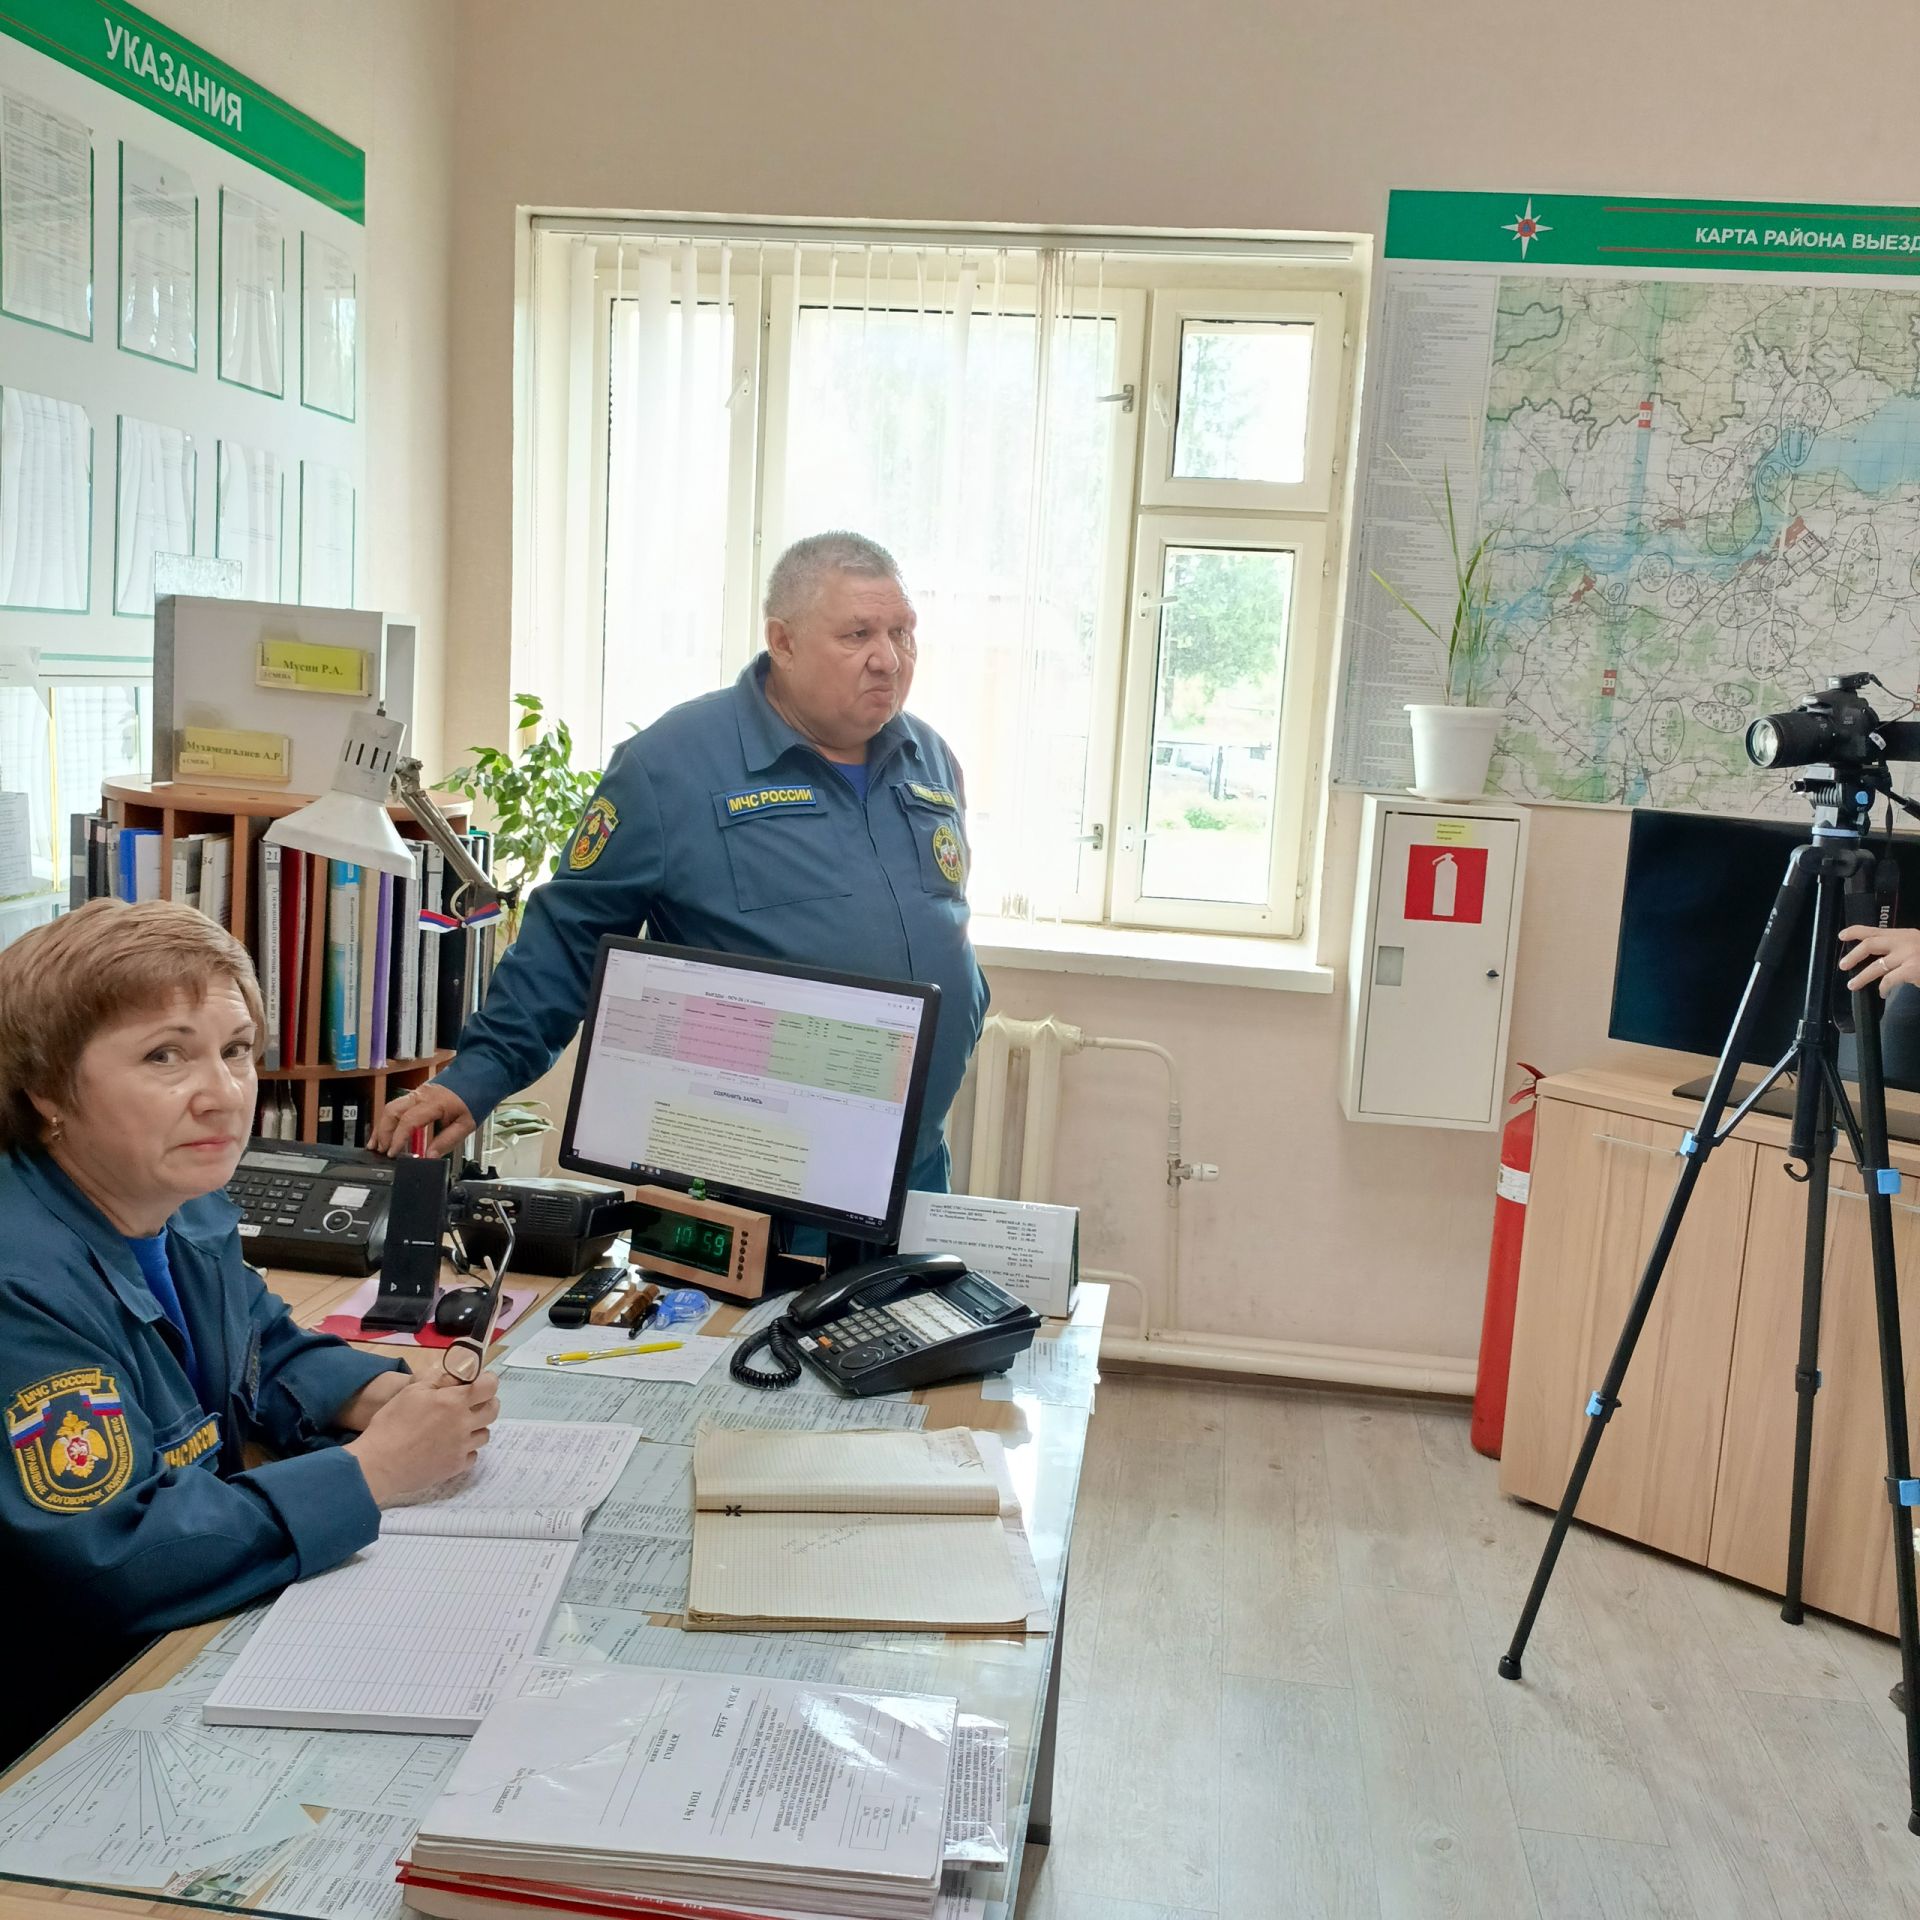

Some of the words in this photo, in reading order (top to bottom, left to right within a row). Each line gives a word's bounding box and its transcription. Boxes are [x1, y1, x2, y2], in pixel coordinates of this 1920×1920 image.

[104, 19, 243, 132] УКАЗАНИЯ
[1695, 228, 1758, 245] КАРТА
[1763, 228, 1846, 248] РАЙОНА
[728, 793, 759, 812] МЧС
[760, 789, 812, 805] РОССИИ
[1879, 905, 1890, 928] non
[344, 1108, 357, 1118] 20
[24, 1386, 50, 1404] МЧС
[52, 1372, 97, 1392] РОССИИ
[661, 1733, 681, 1760] ЖУРНАЛ
